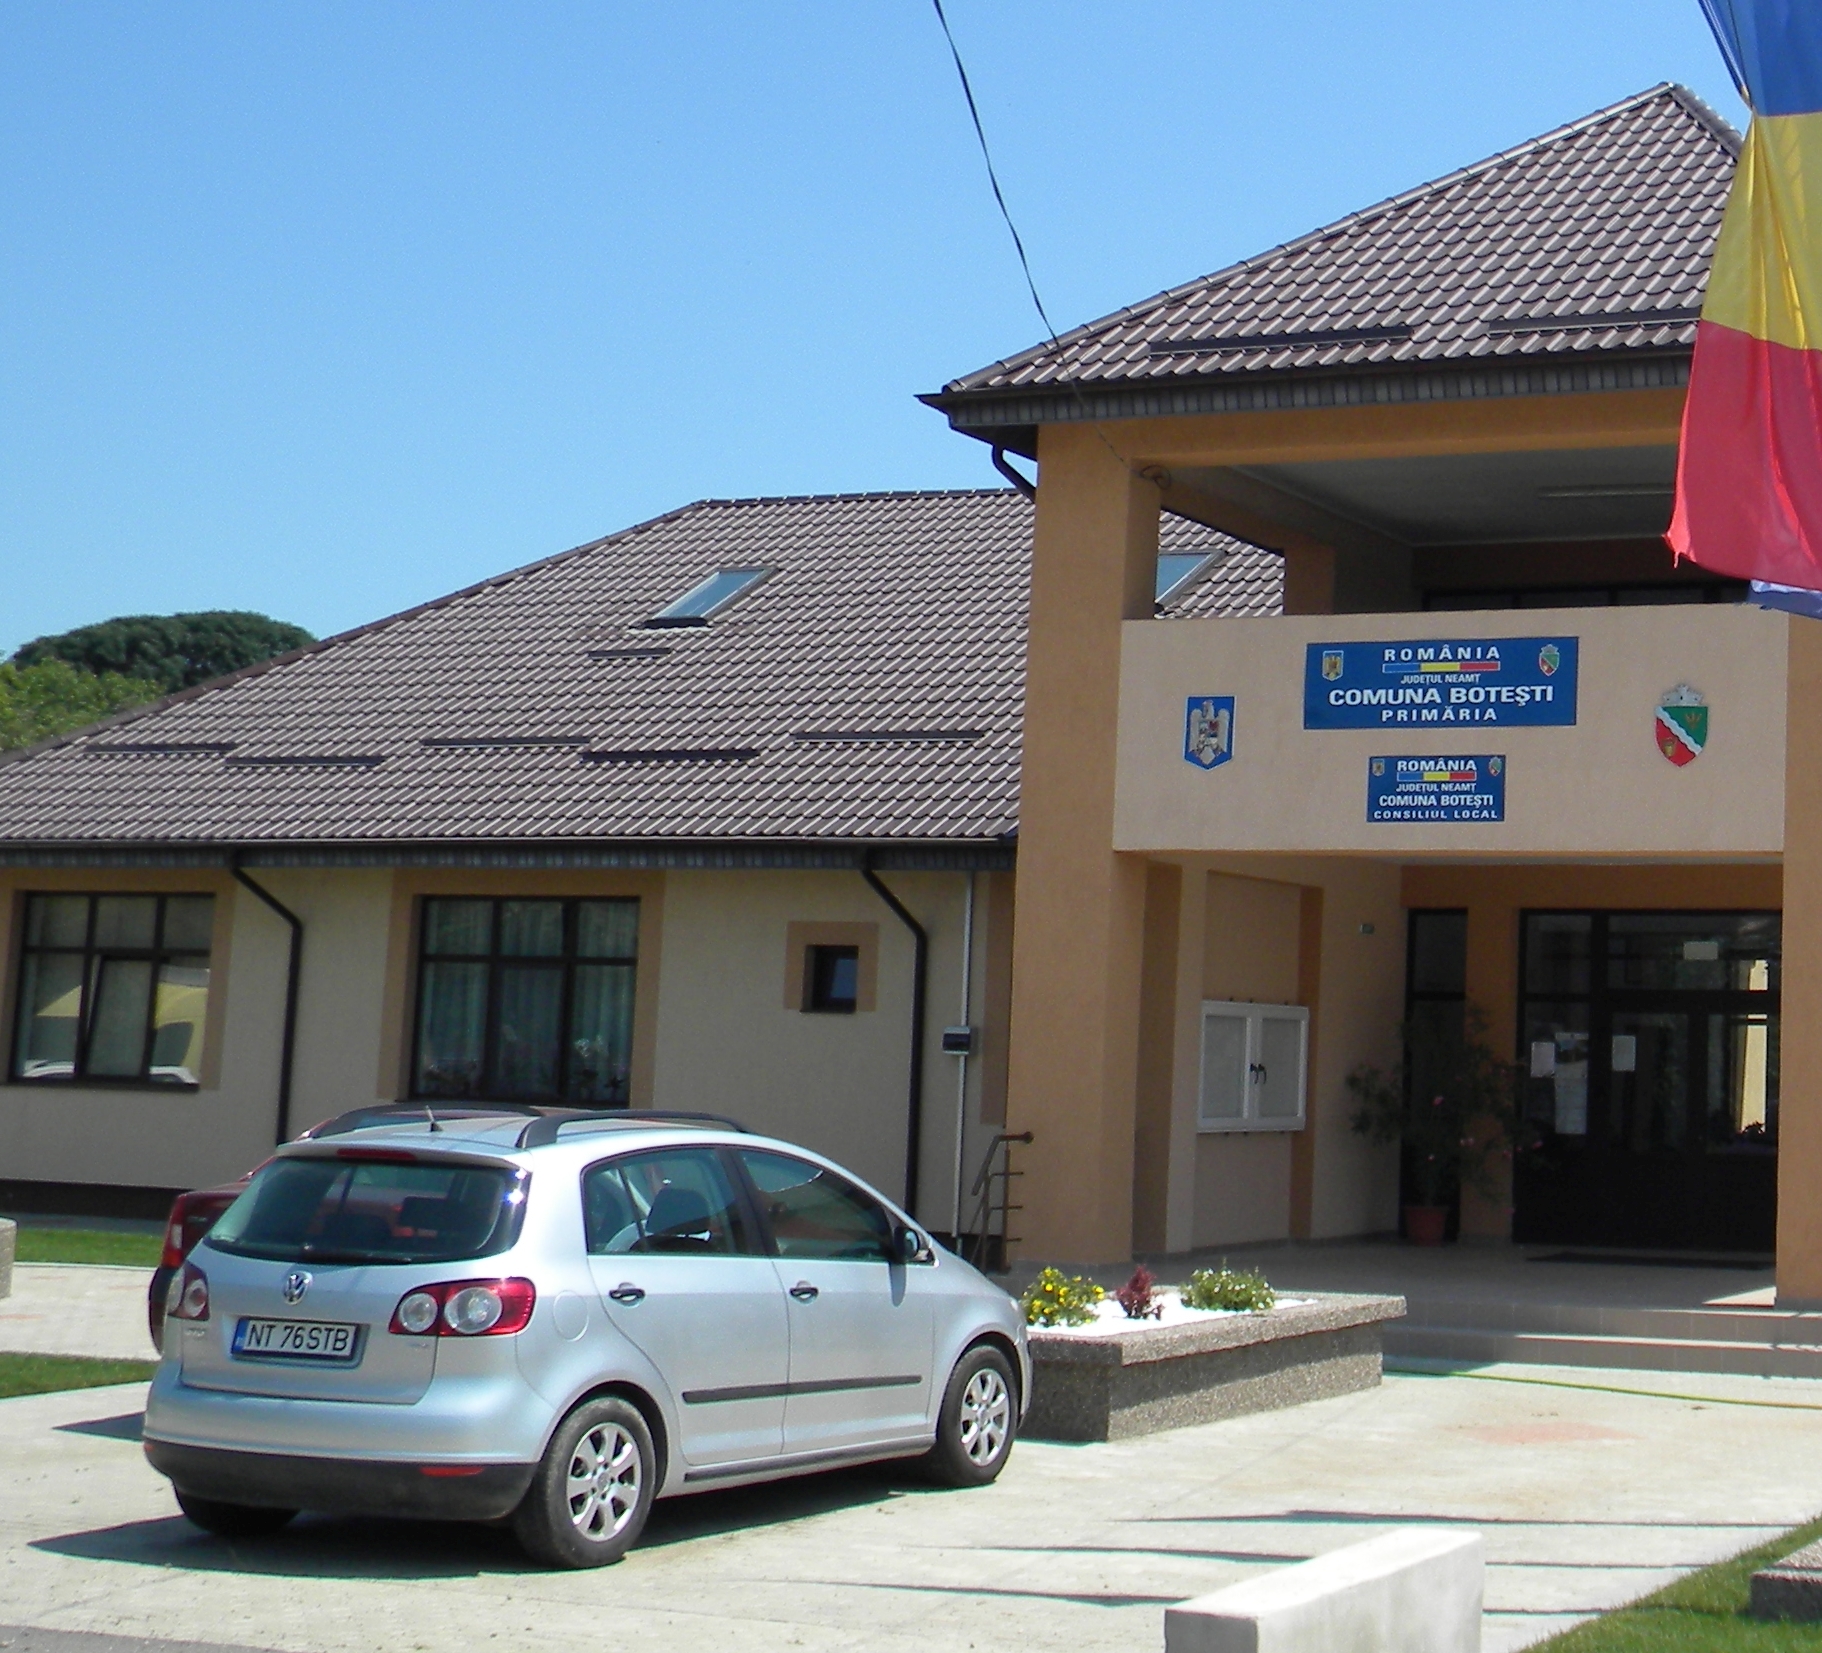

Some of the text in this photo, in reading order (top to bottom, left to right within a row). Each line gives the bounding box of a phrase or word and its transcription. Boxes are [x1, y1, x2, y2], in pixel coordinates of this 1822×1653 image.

[1384, 644, 1500, 662] ROMÂNIA
[1328, 688, 1442, 706] COMUNA
[1381, 706, 1497, 722] PRIMĂRIA
[1397, 758, 1477, 772] ROMÂNIA
[1379, 795, 1436, 807] COMUNA
[1373, 810, 1498, 820] CONSILIUL LOCAL
[247, 1324, 273, 1348] NT
